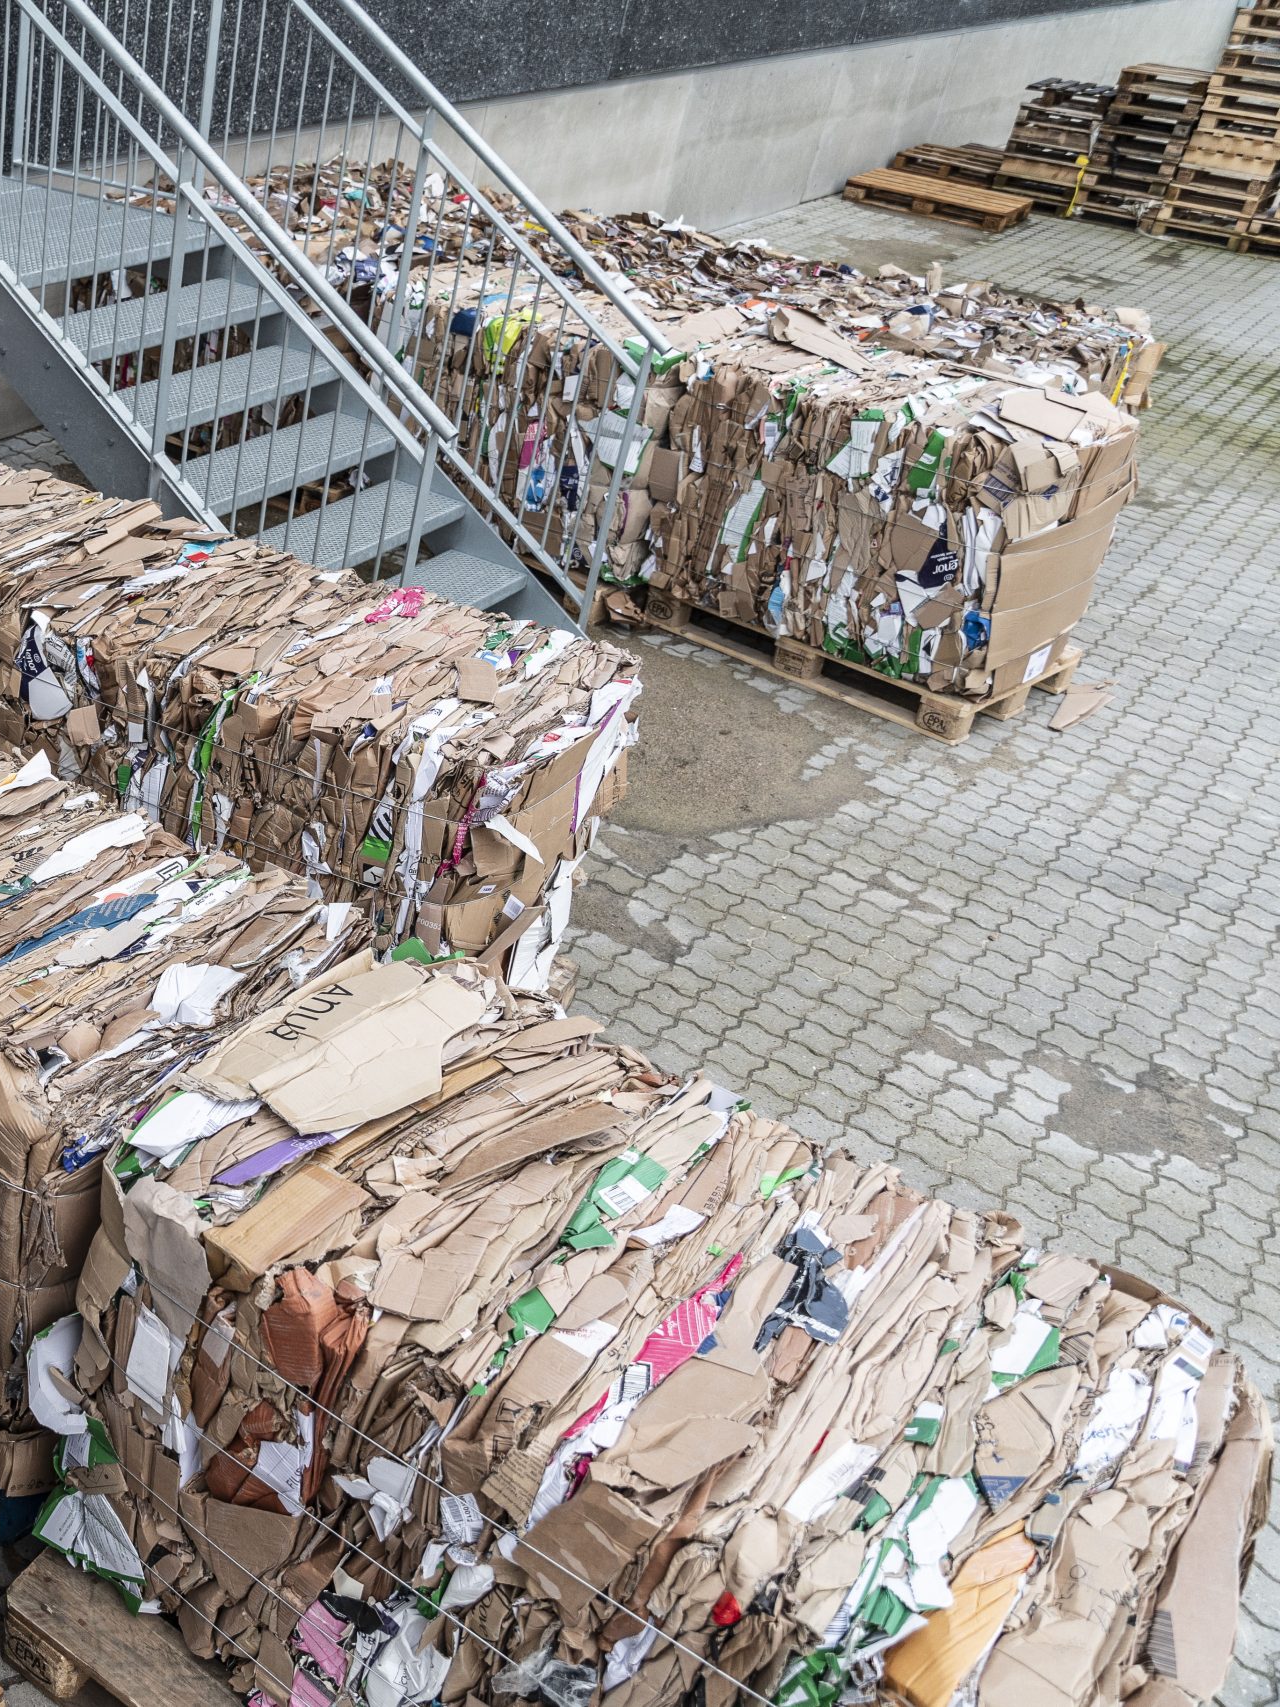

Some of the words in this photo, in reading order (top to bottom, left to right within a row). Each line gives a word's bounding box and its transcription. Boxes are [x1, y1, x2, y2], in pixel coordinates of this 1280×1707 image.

[931, 558, 960, 576] enor
[651, 603, 668, 617] EPAL
[265, 984, 354, 1041] Anua
